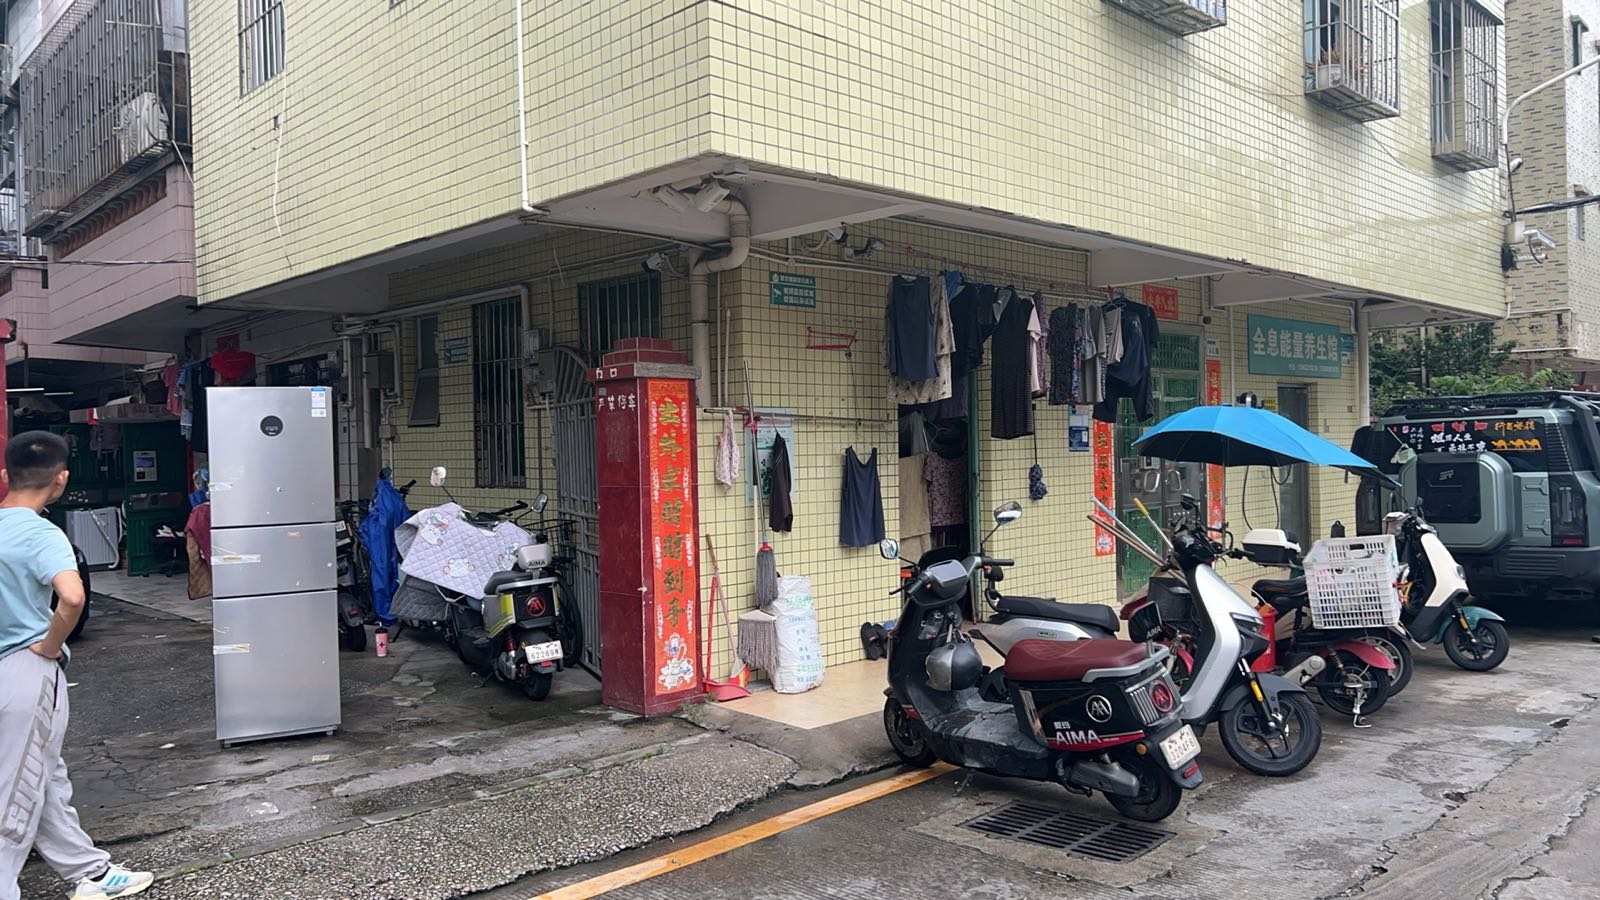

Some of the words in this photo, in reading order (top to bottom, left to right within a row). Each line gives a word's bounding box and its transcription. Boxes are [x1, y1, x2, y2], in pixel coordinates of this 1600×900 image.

[1253, 327, 1338, 361] 全息能量养生馆
[528, 559, 546, 568] AIMA
[1056, 729, 1101, 745] AIMA
